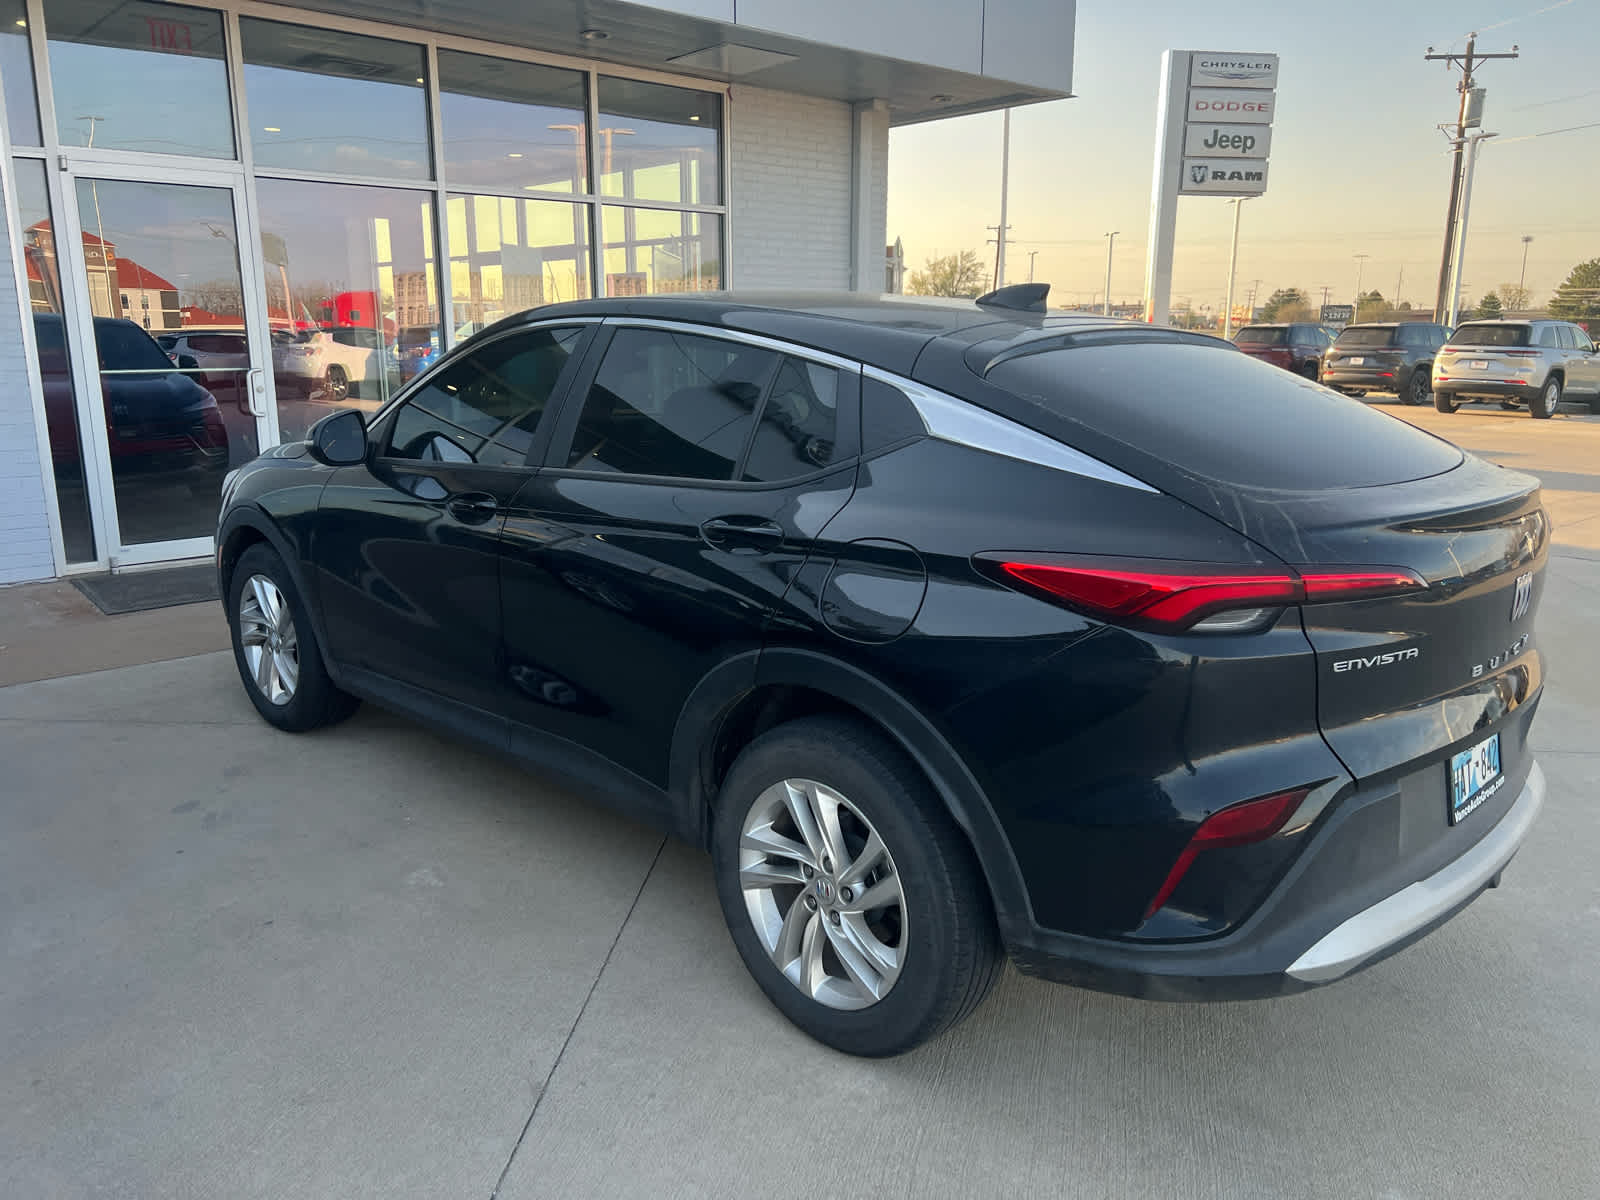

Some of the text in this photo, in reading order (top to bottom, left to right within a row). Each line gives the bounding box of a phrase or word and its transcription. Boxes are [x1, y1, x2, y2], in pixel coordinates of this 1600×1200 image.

[1200, 61, 1272, 70] CHRYSLER
[1195, 100, 1270, 112] DODGE
[1203, 129, 1256, 154] Jeep
[1211, 170, 1263, 182] RAM
[1333, 648, 1419, 673] ENVISTA
